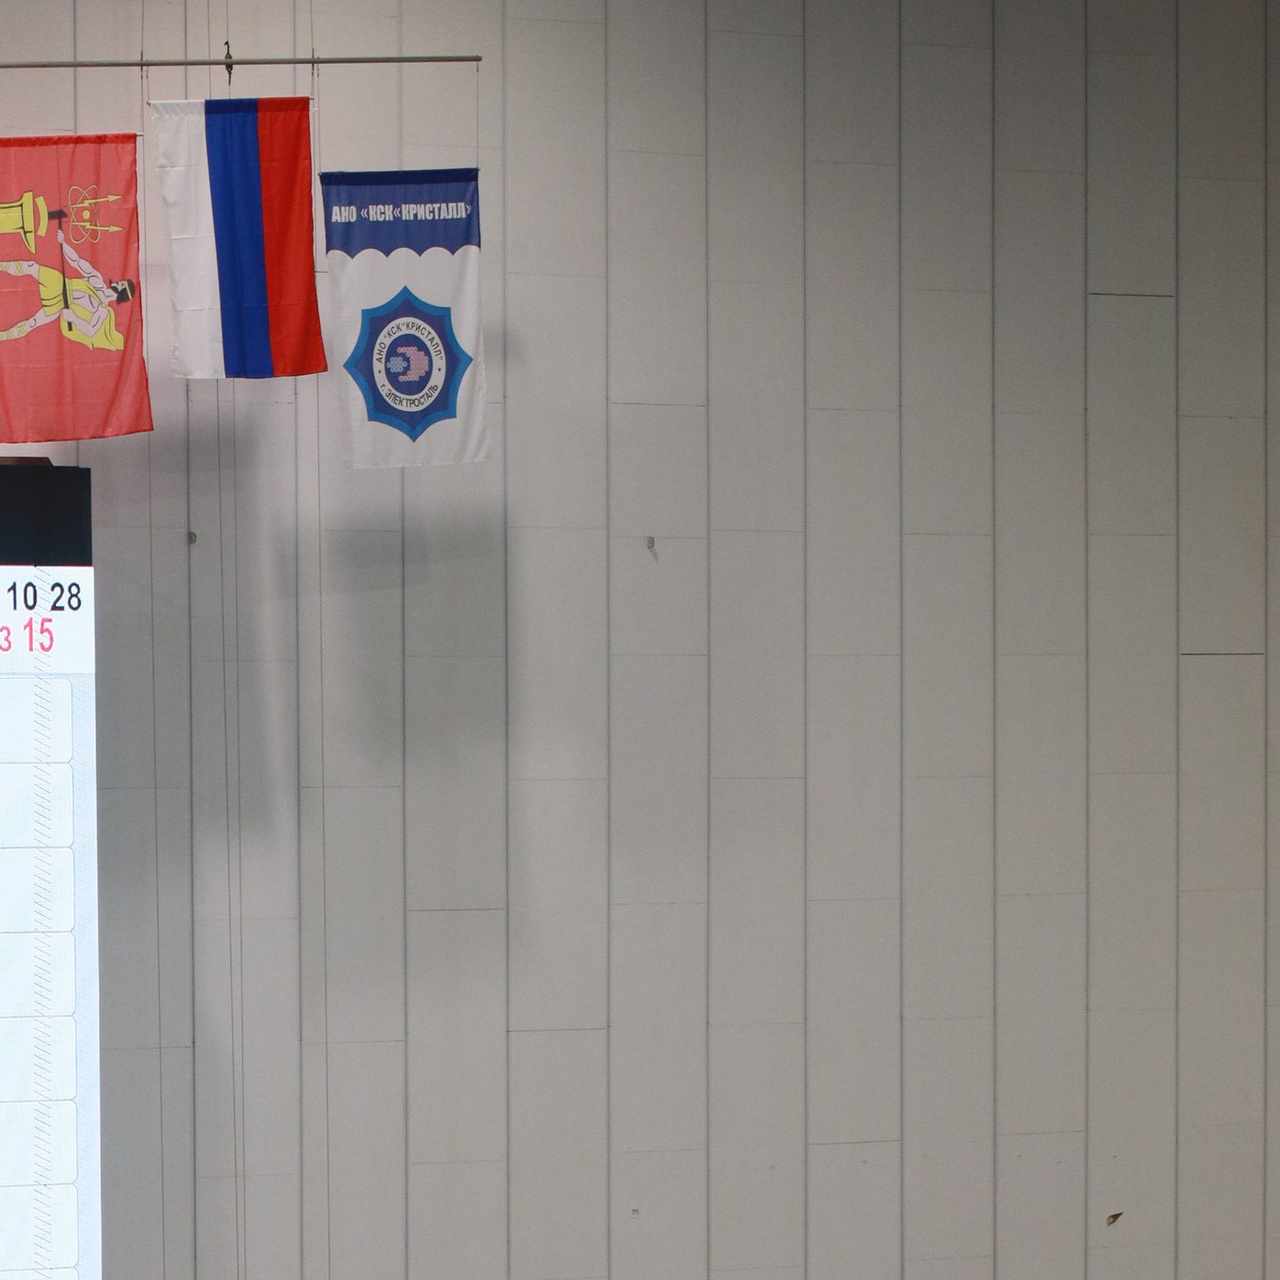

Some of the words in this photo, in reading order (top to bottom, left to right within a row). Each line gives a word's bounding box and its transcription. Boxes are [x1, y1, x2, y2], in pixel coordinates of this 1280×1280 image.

[331, 205, 357, 222] АНО
[375, 340, 387, 364] АНО
[22, 616, 55, 653] 15
